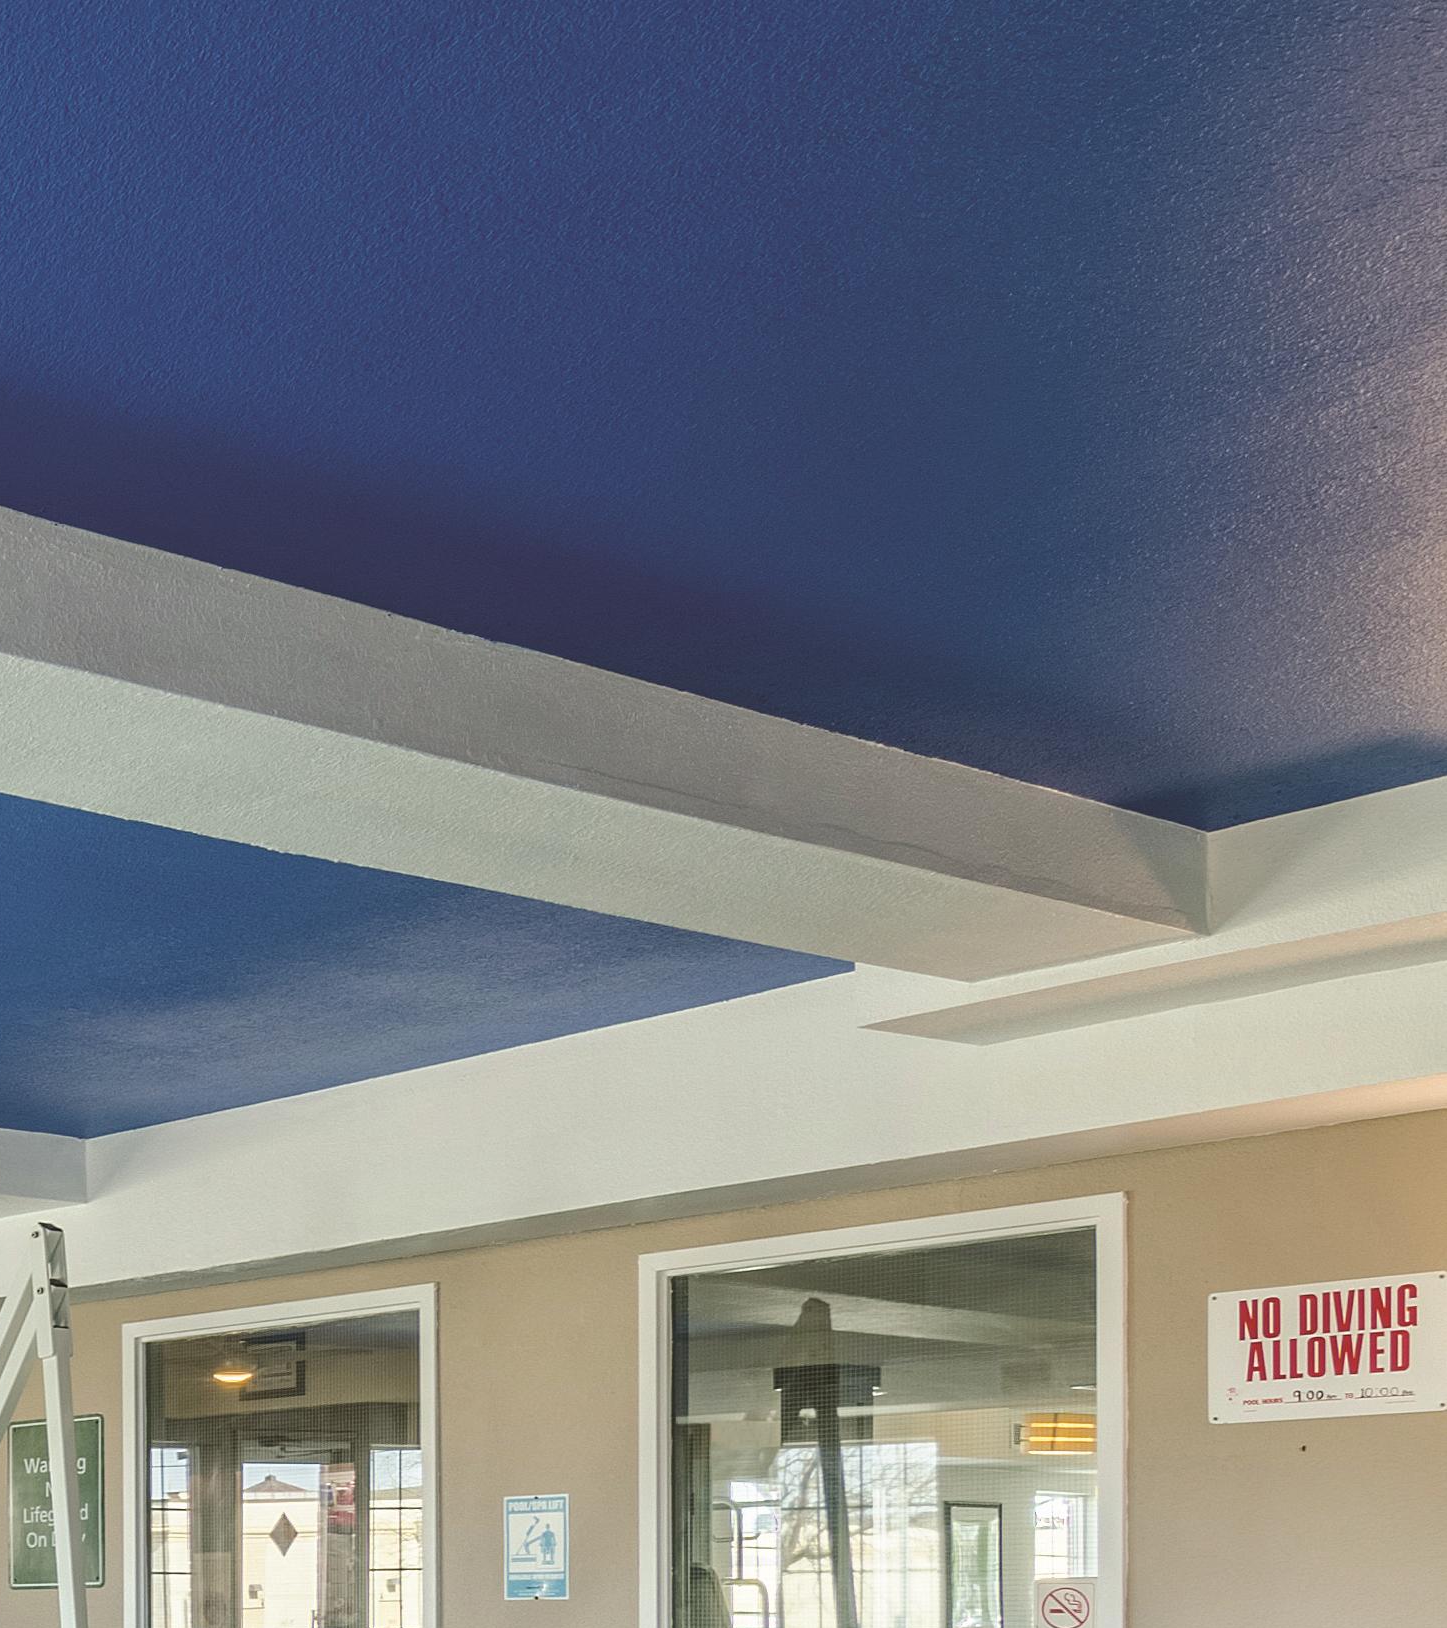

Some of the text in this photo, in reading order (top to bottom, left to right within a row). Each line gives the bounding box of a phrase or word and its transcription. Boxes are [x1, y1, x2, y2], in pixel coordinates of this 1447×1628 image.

[1239, 1283, 1418, 1340] NO DIVING
[1246, 1330, 1410, 1382] ALLOWED
[23, 1503, 89, 1526] Lifegd
[26, 1532, 47, 1547] On
